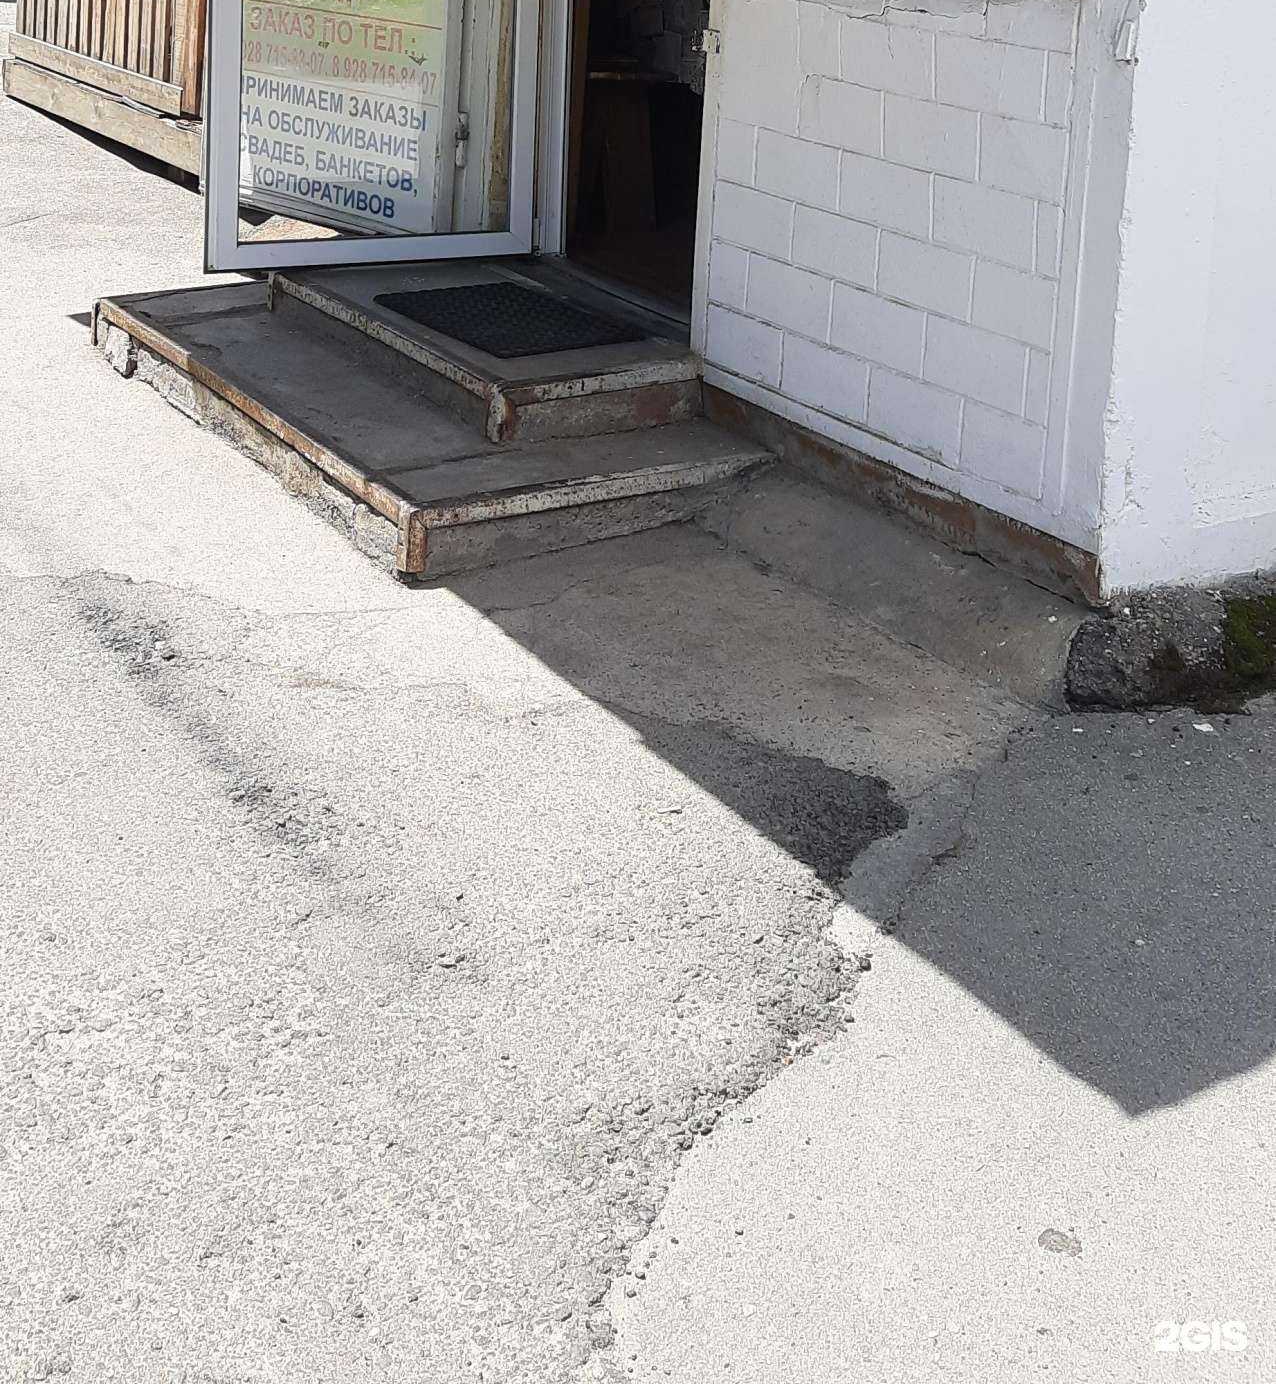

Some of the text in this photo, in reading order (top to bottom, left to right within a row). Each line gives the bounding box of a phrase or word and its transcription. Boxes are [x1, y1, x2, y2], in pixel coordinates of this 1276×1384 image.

[250, 6, 315, 40] ЗАКАЗ
[322, 17, 354, 44] ПО
[332, 56, 340, 78] 8
[345, 58, 368, 83] 928
[241, 104, 418, 162] НА ОБСЛУЖИВАНИЕ
[349, 96, 426, 131] ЗАКАЗЫ
[253, 163, 395, 219] КОРПОРАТИВОВ
[316, 150, 418, 196] БАНКЕТОВ,
